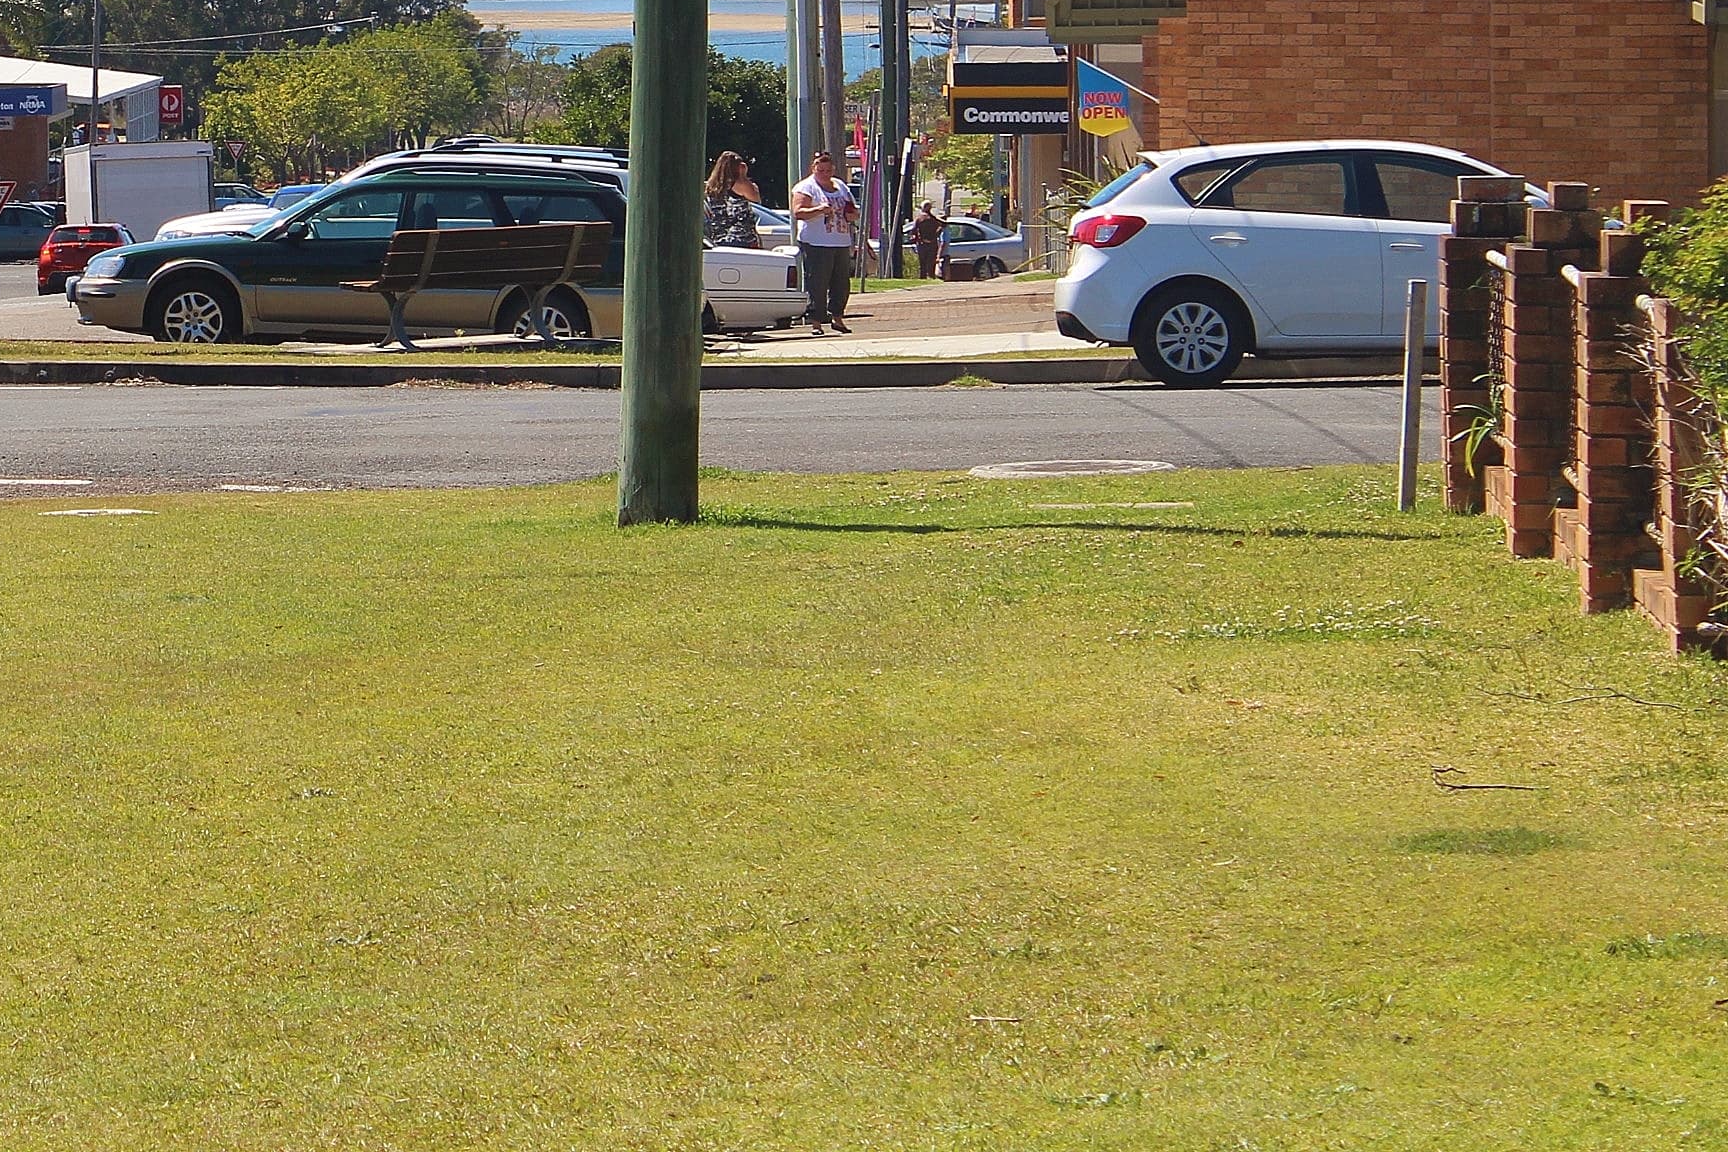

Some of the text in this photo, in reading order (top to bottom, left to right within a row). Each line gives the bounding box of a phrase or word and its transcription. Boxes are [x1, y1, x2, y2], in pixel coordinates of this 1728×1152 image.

[1083, 91, 1122, 105] NOW
[963, 107, 1070, 123] Commonwe
[1082, 106, 1127, 120] OPEN
